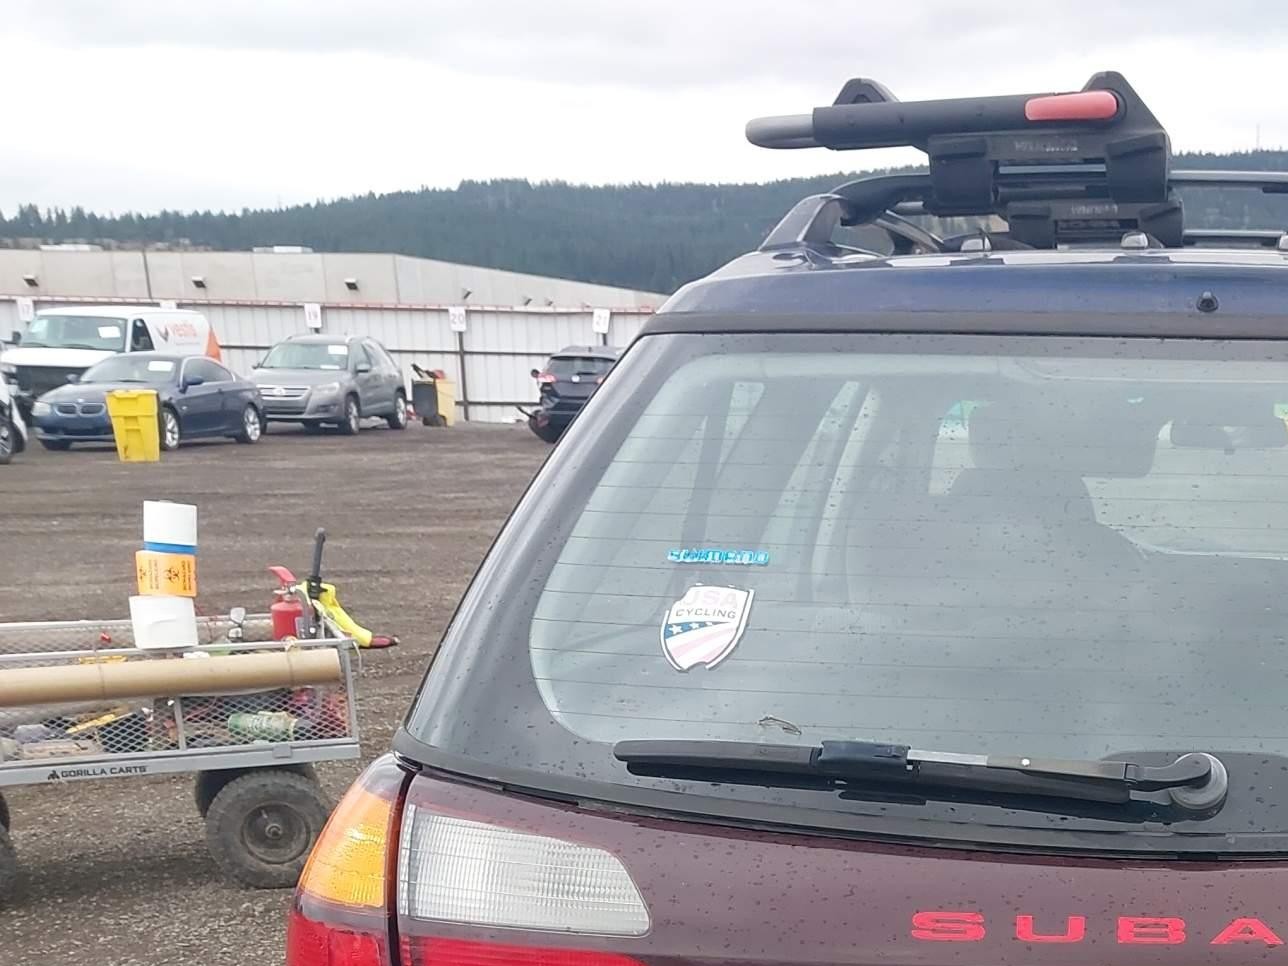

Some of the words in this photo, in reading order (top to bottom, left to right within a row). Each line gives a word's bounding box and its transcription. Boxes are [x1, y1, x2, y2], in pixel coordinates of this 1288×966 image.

[451, 313, 465, 325] 20
[675, 607, 737, 620] CYCLING
[61, 767, 107, 778] GORILLA
[110, 766, 147, 775] CARTS
